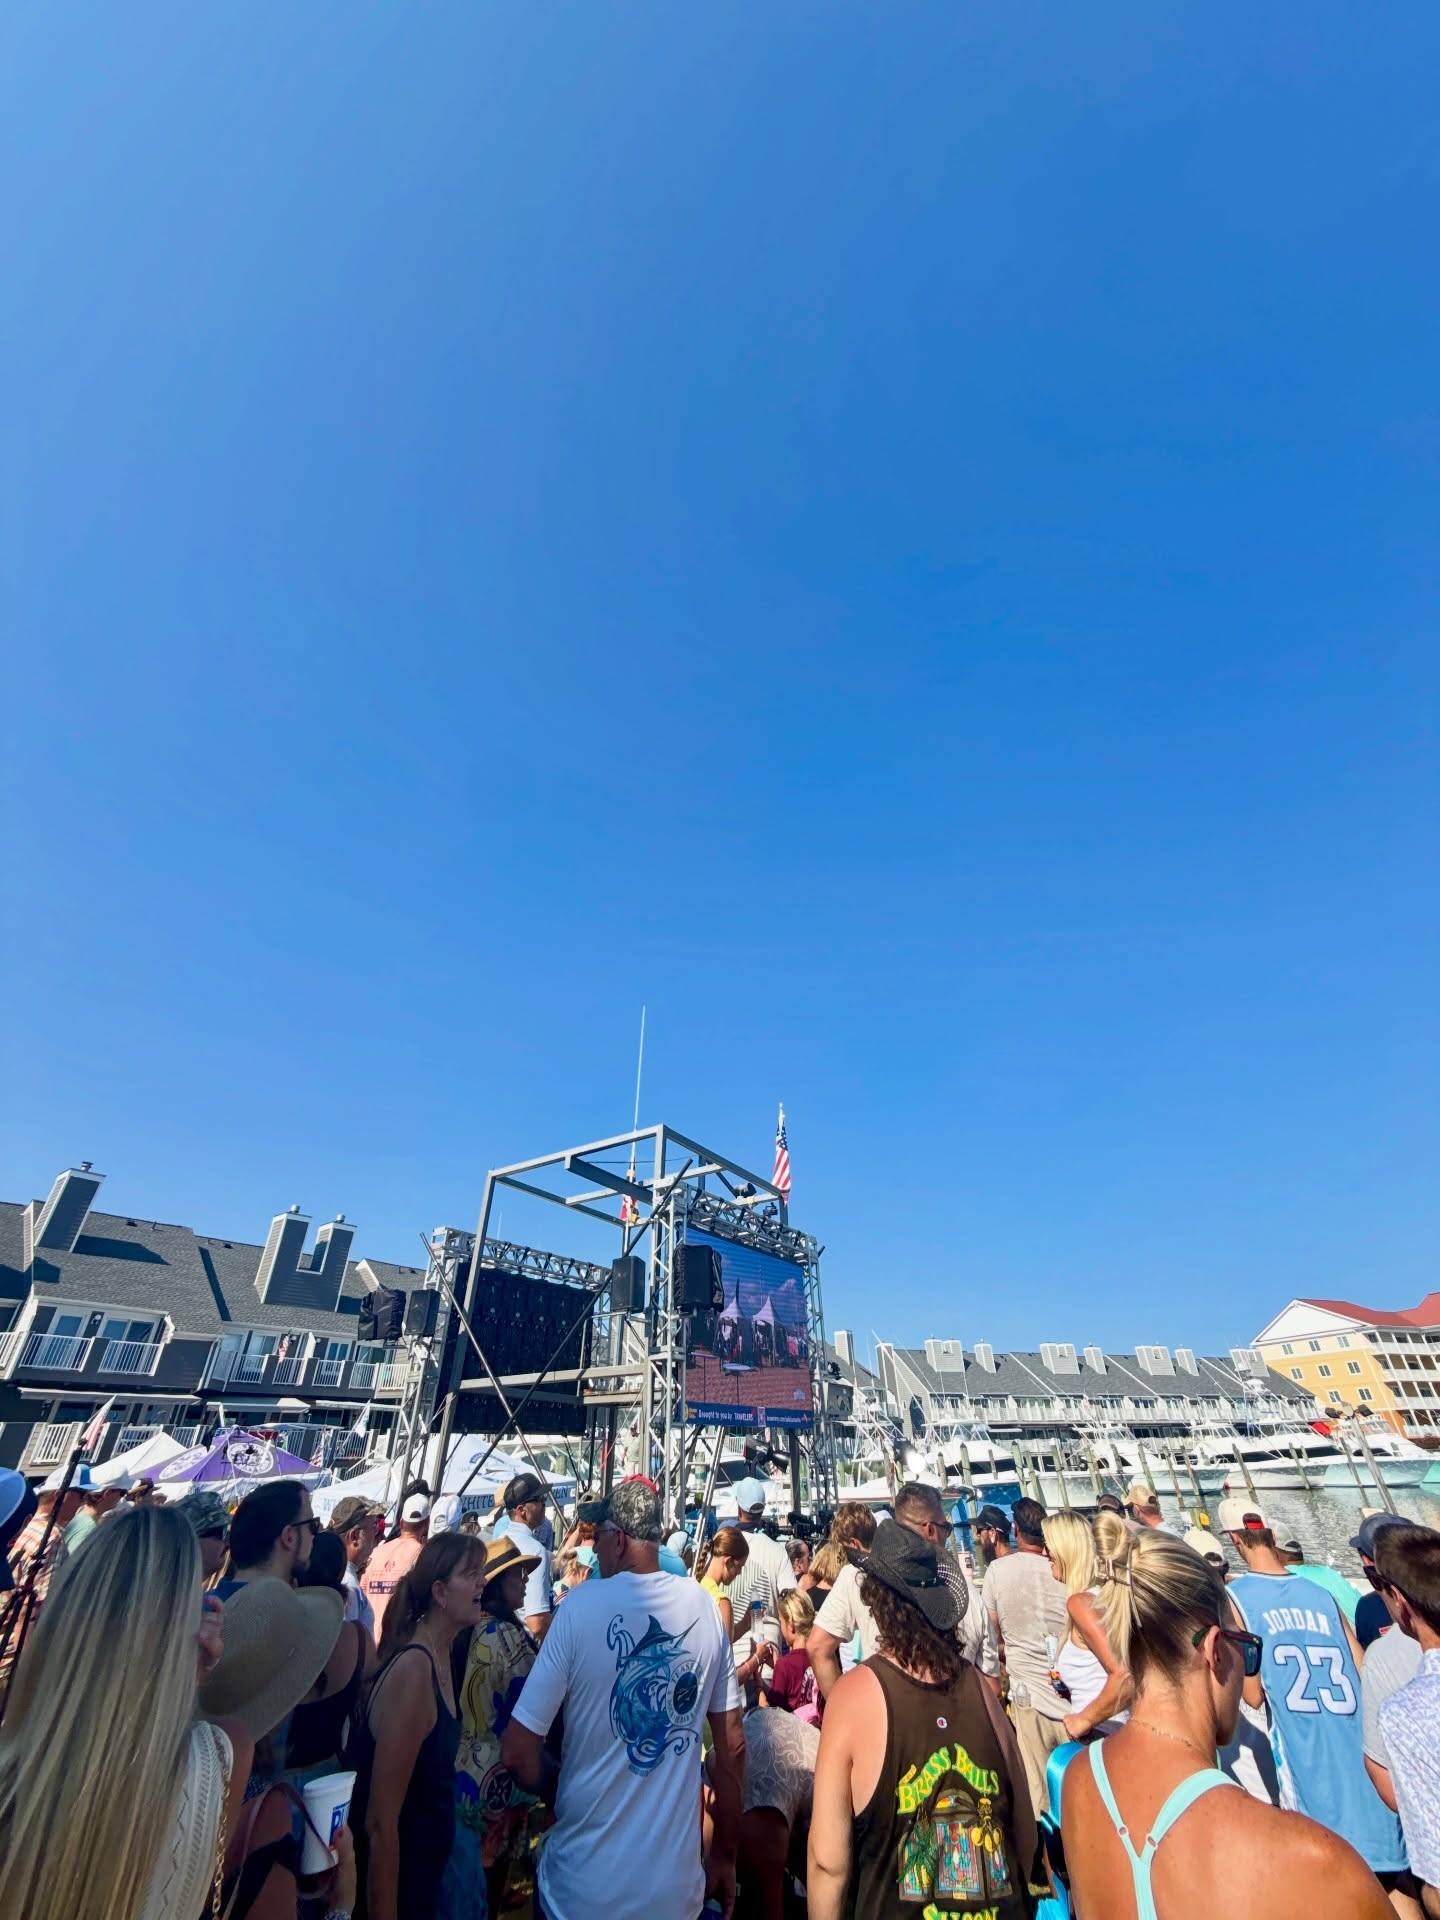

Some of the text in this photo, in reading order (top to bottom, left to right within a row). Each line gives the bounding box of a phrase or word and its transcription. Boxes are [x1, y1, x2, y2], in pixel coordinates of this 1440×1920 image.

[734, 1412, 753, 1421] TRAVELERS
[1263, 1607, 1331, 1636] JORDAN
[1273, 1643, 1358, 1715] 23
[897, 1742, 1000, 1815] BRASS BALLS
